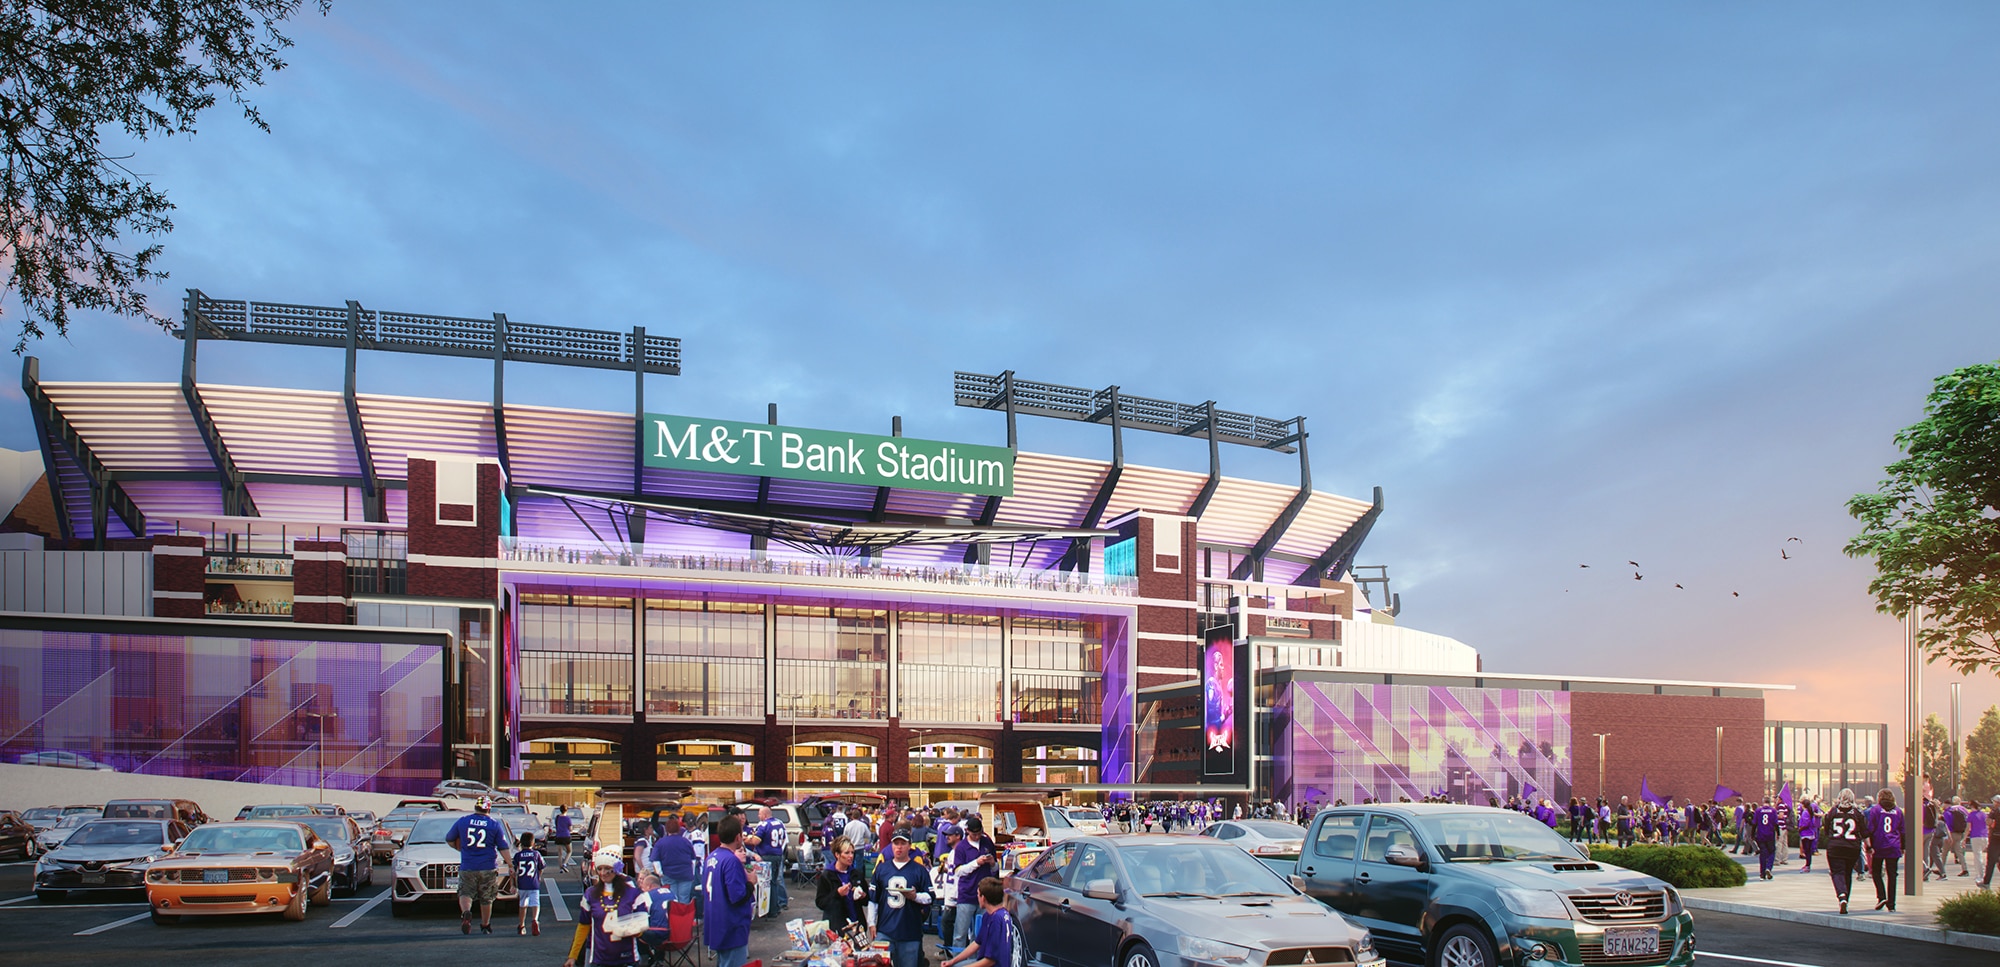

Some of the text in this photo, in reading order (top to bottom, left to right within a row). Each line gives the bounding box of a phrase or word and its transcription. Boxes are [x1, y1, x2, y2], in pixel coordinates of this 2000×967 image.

[653, 420, 1004, 487] M&T Bank Stadium
[1762, 813, 1769, 825] 8
[1883, 816, 1892, 833] 8
[1832, 817, 1857, 840] 52
[466, 827, 487, 848] 52
[518, 860, 535, 877] 52
[1607, 938, 1655, 951] 5EAW252
